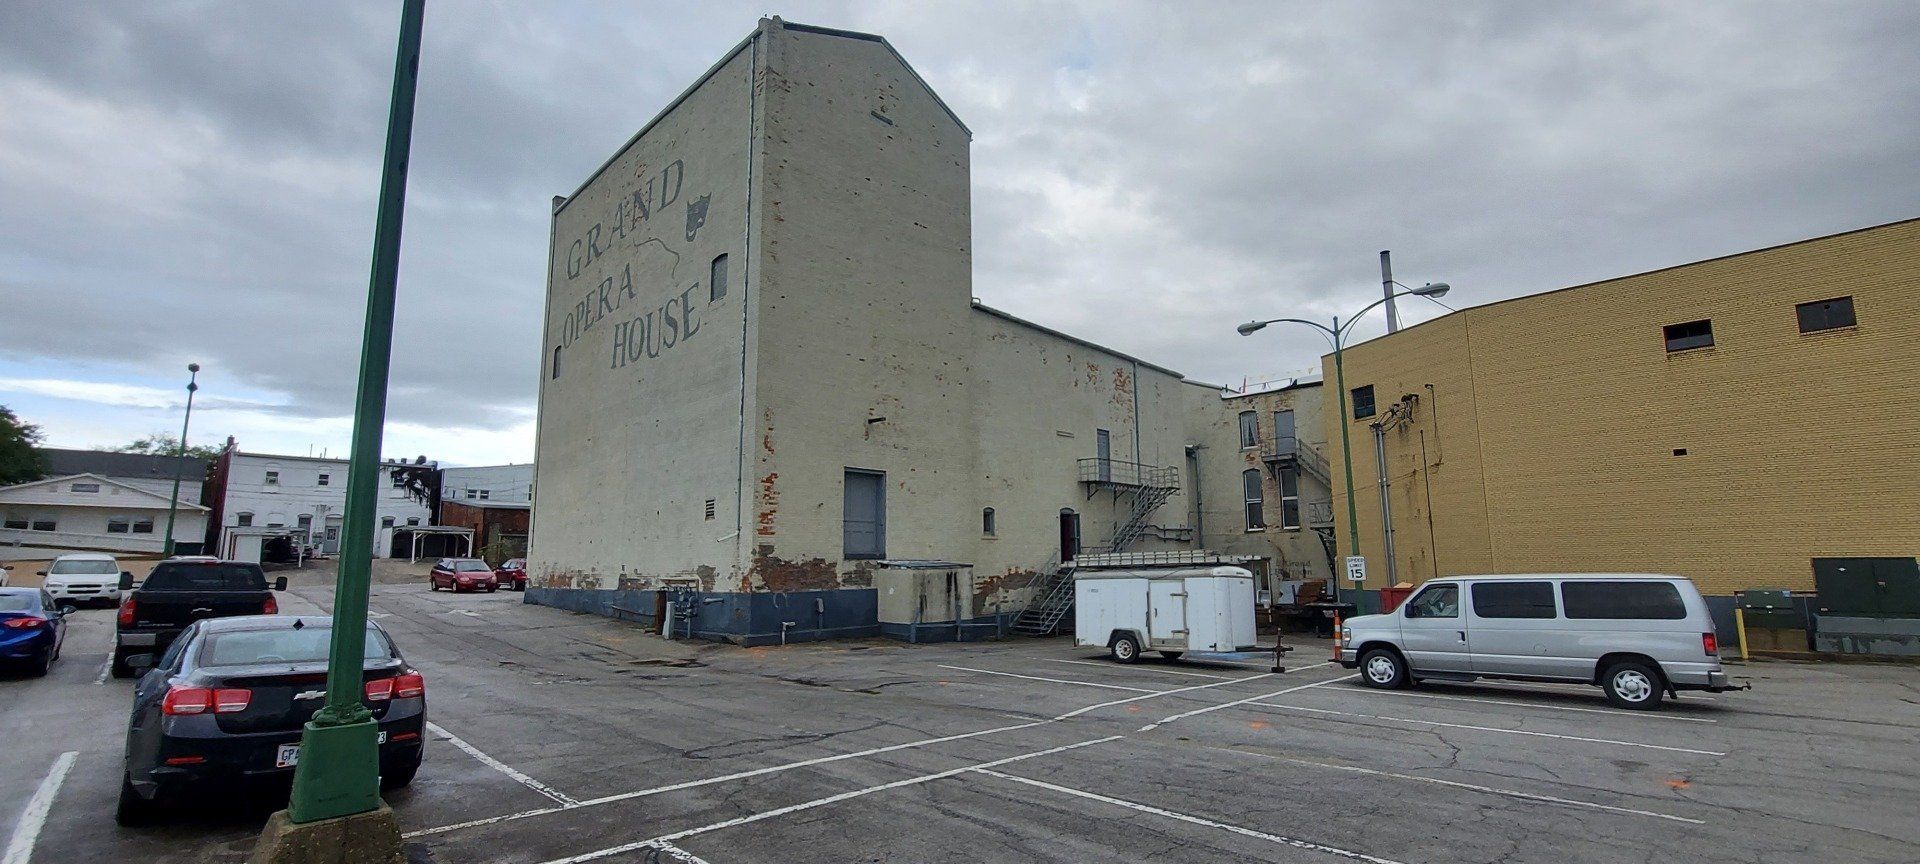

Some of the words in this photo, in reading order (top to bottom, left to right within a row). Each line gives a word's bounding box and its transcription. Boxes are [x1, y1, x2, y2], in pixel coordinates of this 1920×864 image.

[567, 159, 684, 280] GRAND
[562, 263, 636, 349] OPERA
[611, 282, 700, 369] HOUSE
[1350, 569, 1363, 578] 15
